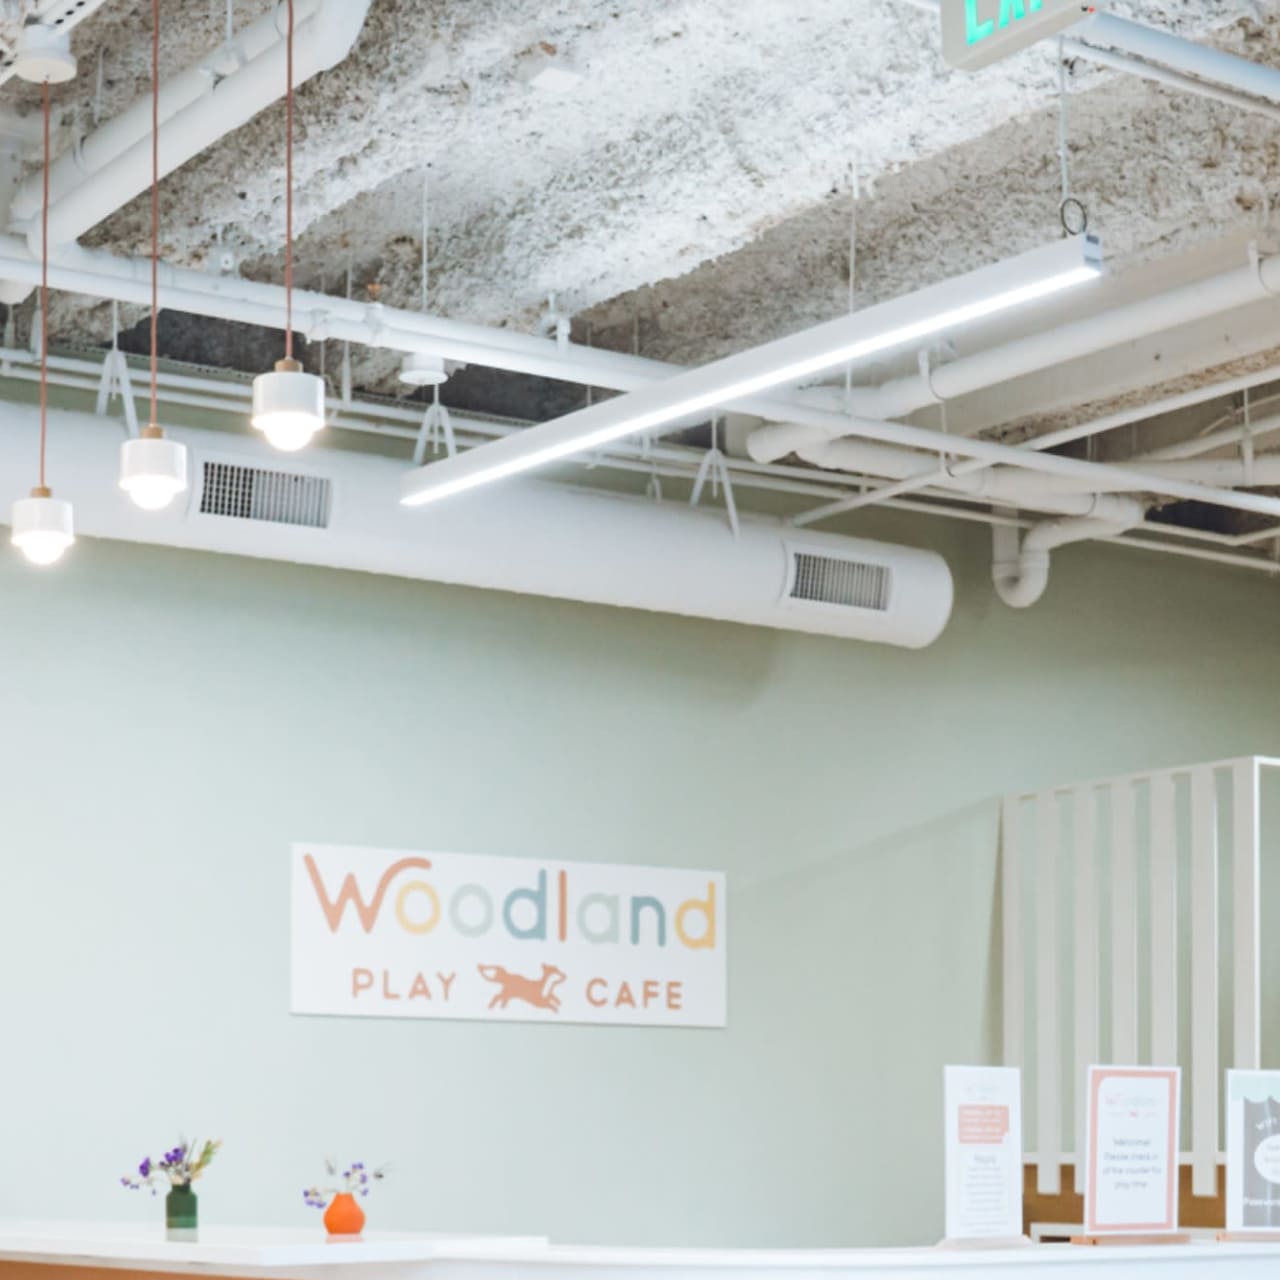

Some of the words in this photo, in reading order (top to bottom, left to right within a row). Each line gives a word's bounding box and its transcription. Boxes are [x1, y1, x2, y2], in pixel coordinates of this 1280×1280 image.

[303, 853, 717, 950] Woodland
[351, 967, 456, 1001] PLAY
[585, 977, 683, 1010] CAFE
